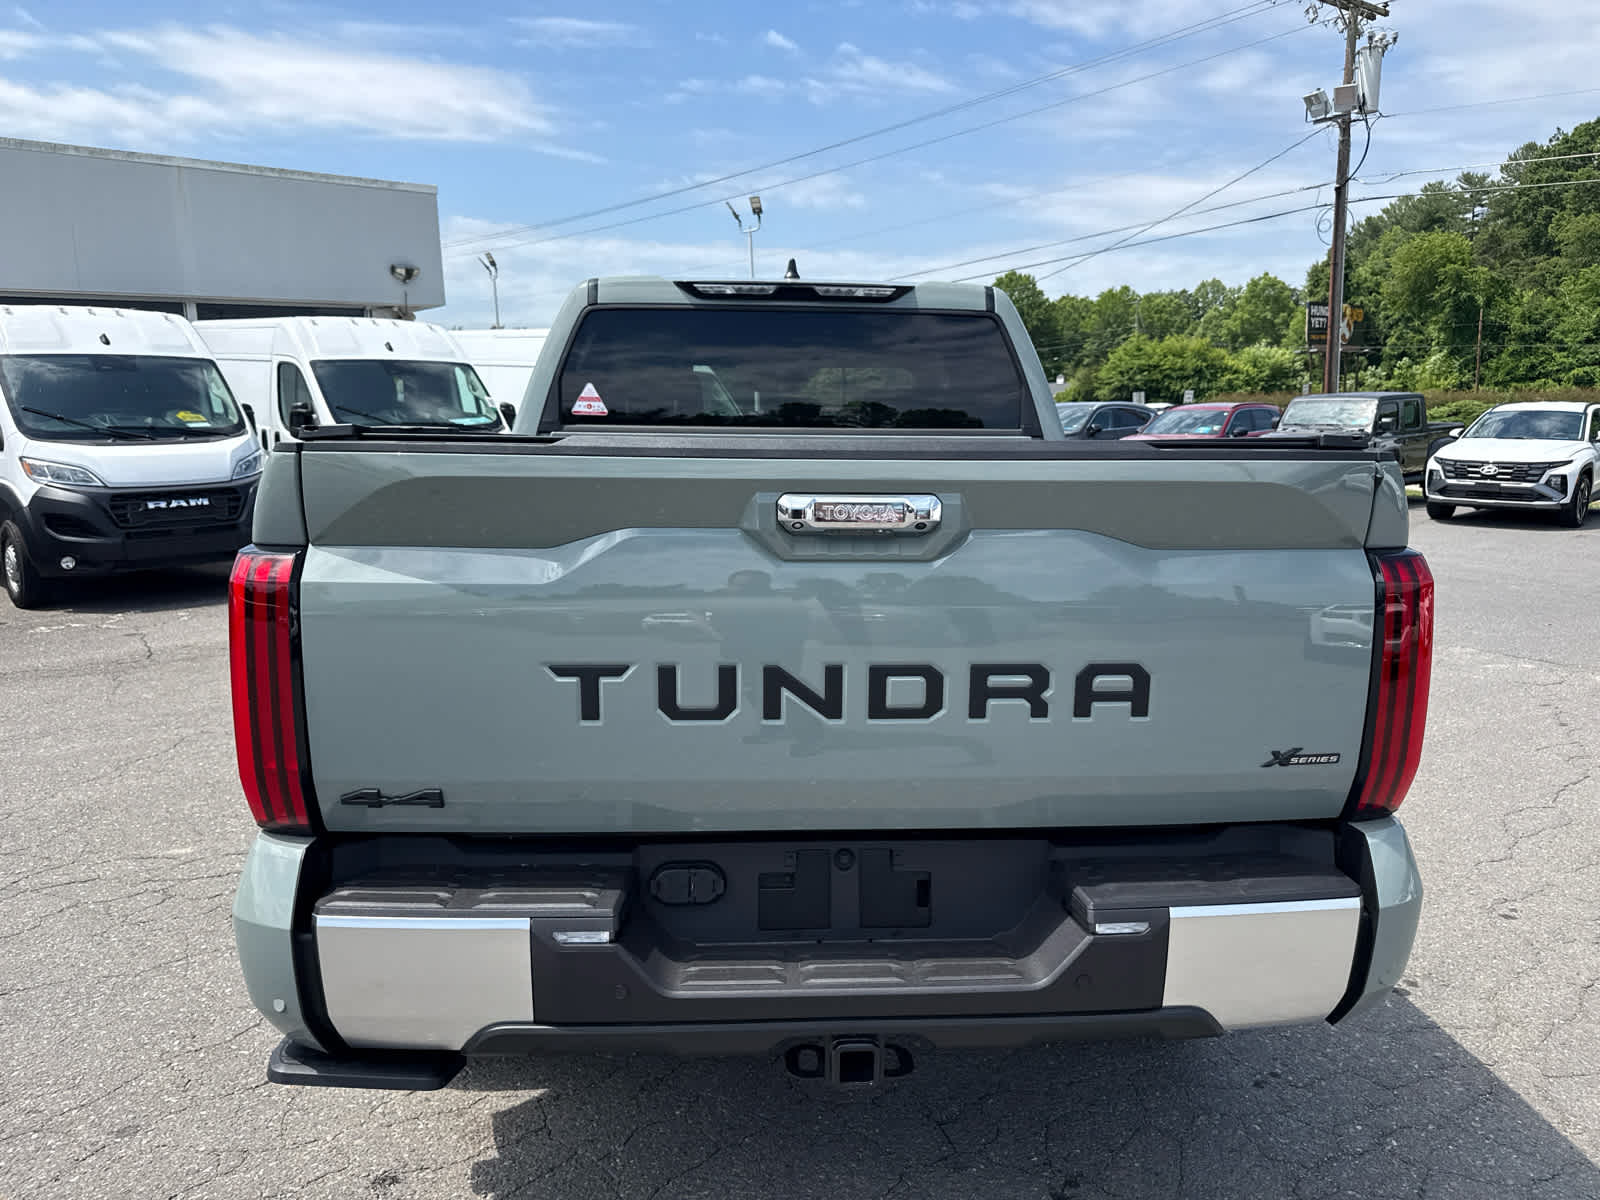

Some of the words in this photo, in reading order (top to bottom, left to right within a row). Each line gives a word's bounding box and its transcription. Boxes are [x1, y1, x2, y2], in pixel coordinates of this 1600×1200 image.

[1311, 305, 1329, 316] HUNG
[147, 498, 210, 509] RAM
[822, 504, 899, 521] TOYOTA
[545, 663, 1152, 726] TUNDRA
